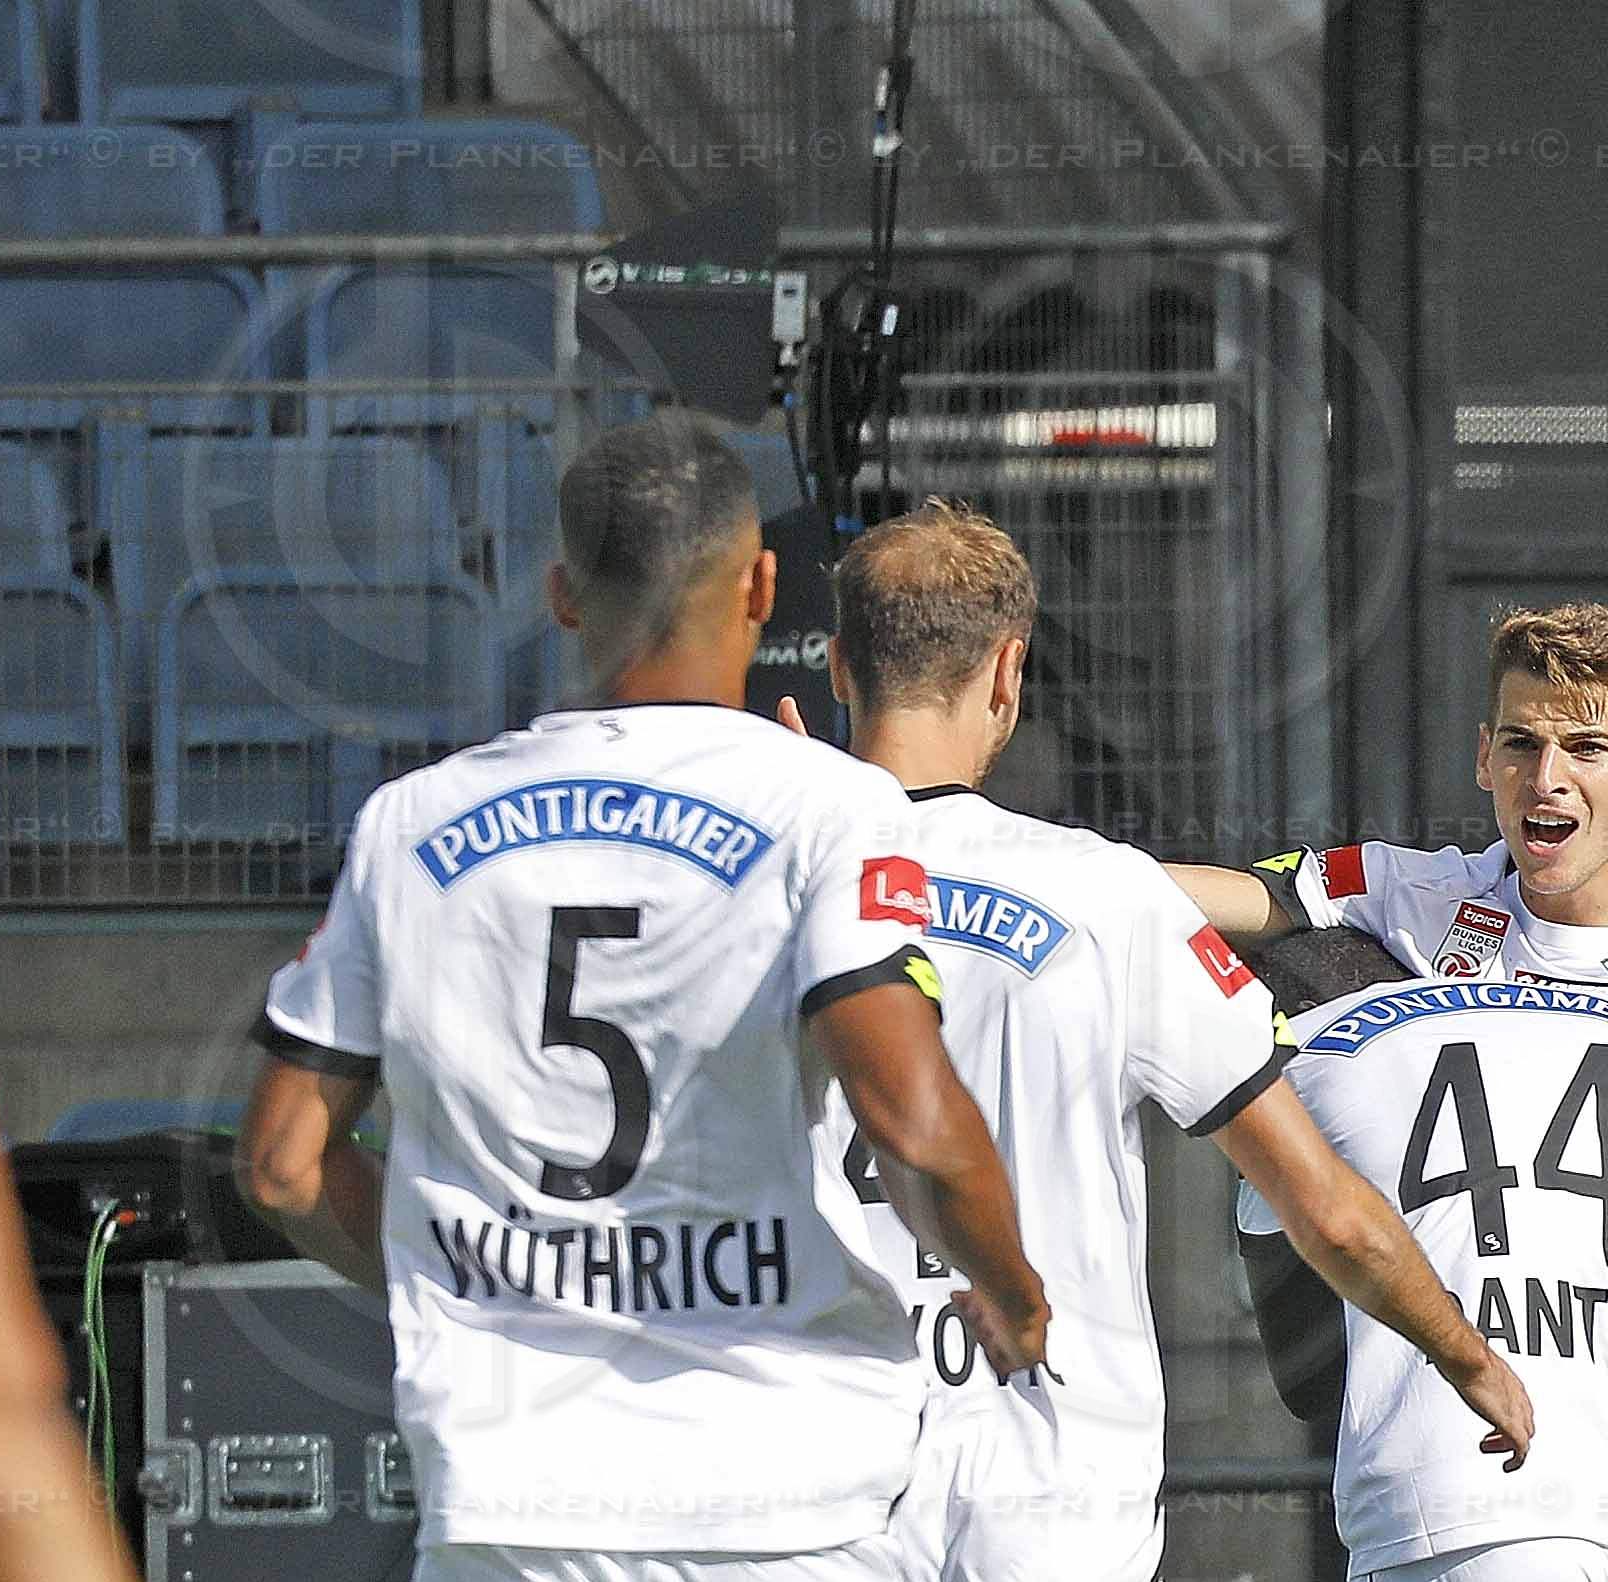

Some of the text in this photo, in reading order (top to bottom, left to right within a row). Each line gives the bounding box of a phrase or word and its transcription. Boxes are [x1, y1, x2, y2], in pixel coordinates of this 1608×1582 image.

[430, 785, 758, 878] PUNTIGAMER
[1452, 927, 1498, 949] BUNDES
[1463, 906, 1505, 929] tipico
[1457, 939, 1484, 955] LIGA
[540, 905, 651, 1201] 5
[428, 1203, 790, 1314] WÜTHRICH
